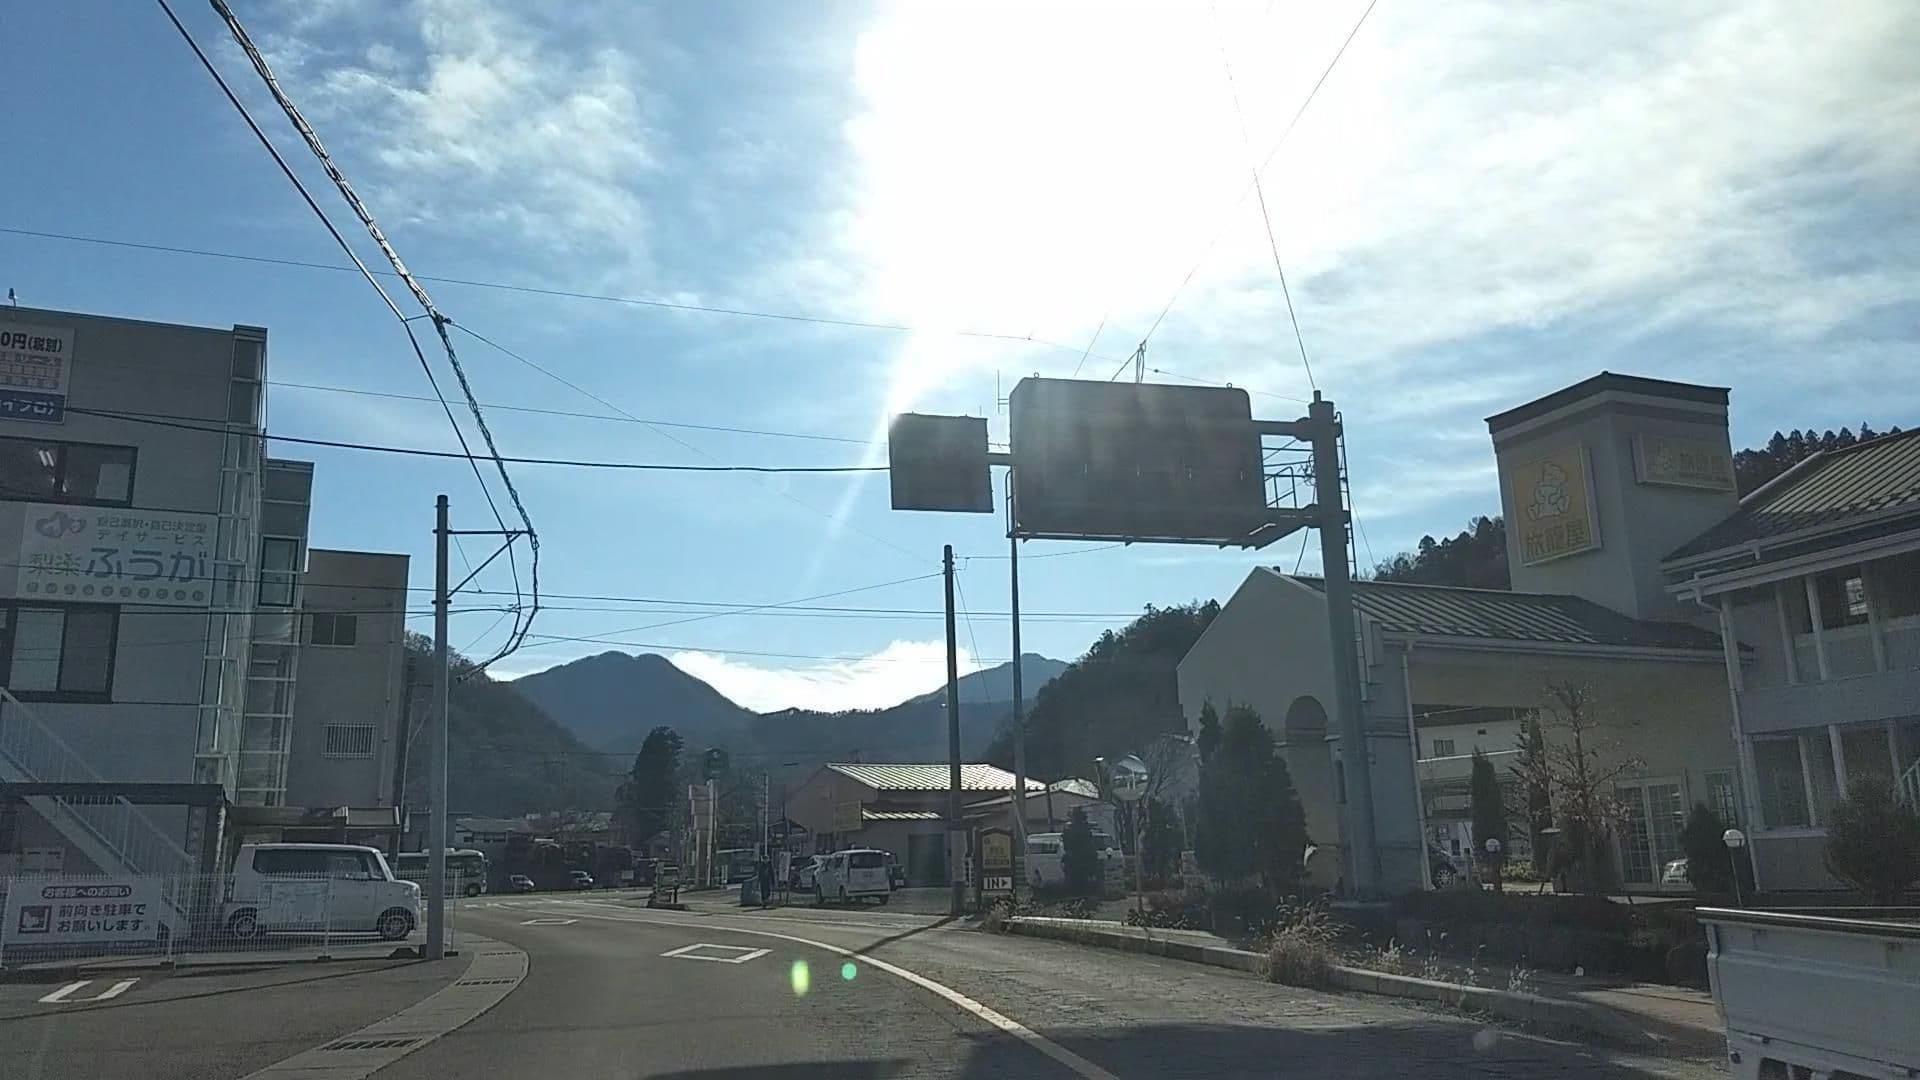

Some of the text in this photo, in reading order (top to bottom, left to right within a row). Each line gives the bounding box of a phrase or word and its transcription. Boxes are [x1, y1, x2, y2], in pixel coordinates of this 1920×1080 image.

[97, 530, 205, 546] デイサービス
[986, 877, 1000, 889] IN
[44, 885, 130, 898] お客様へのお願い
[58, 903, 146, 917] 前向き駐車で
